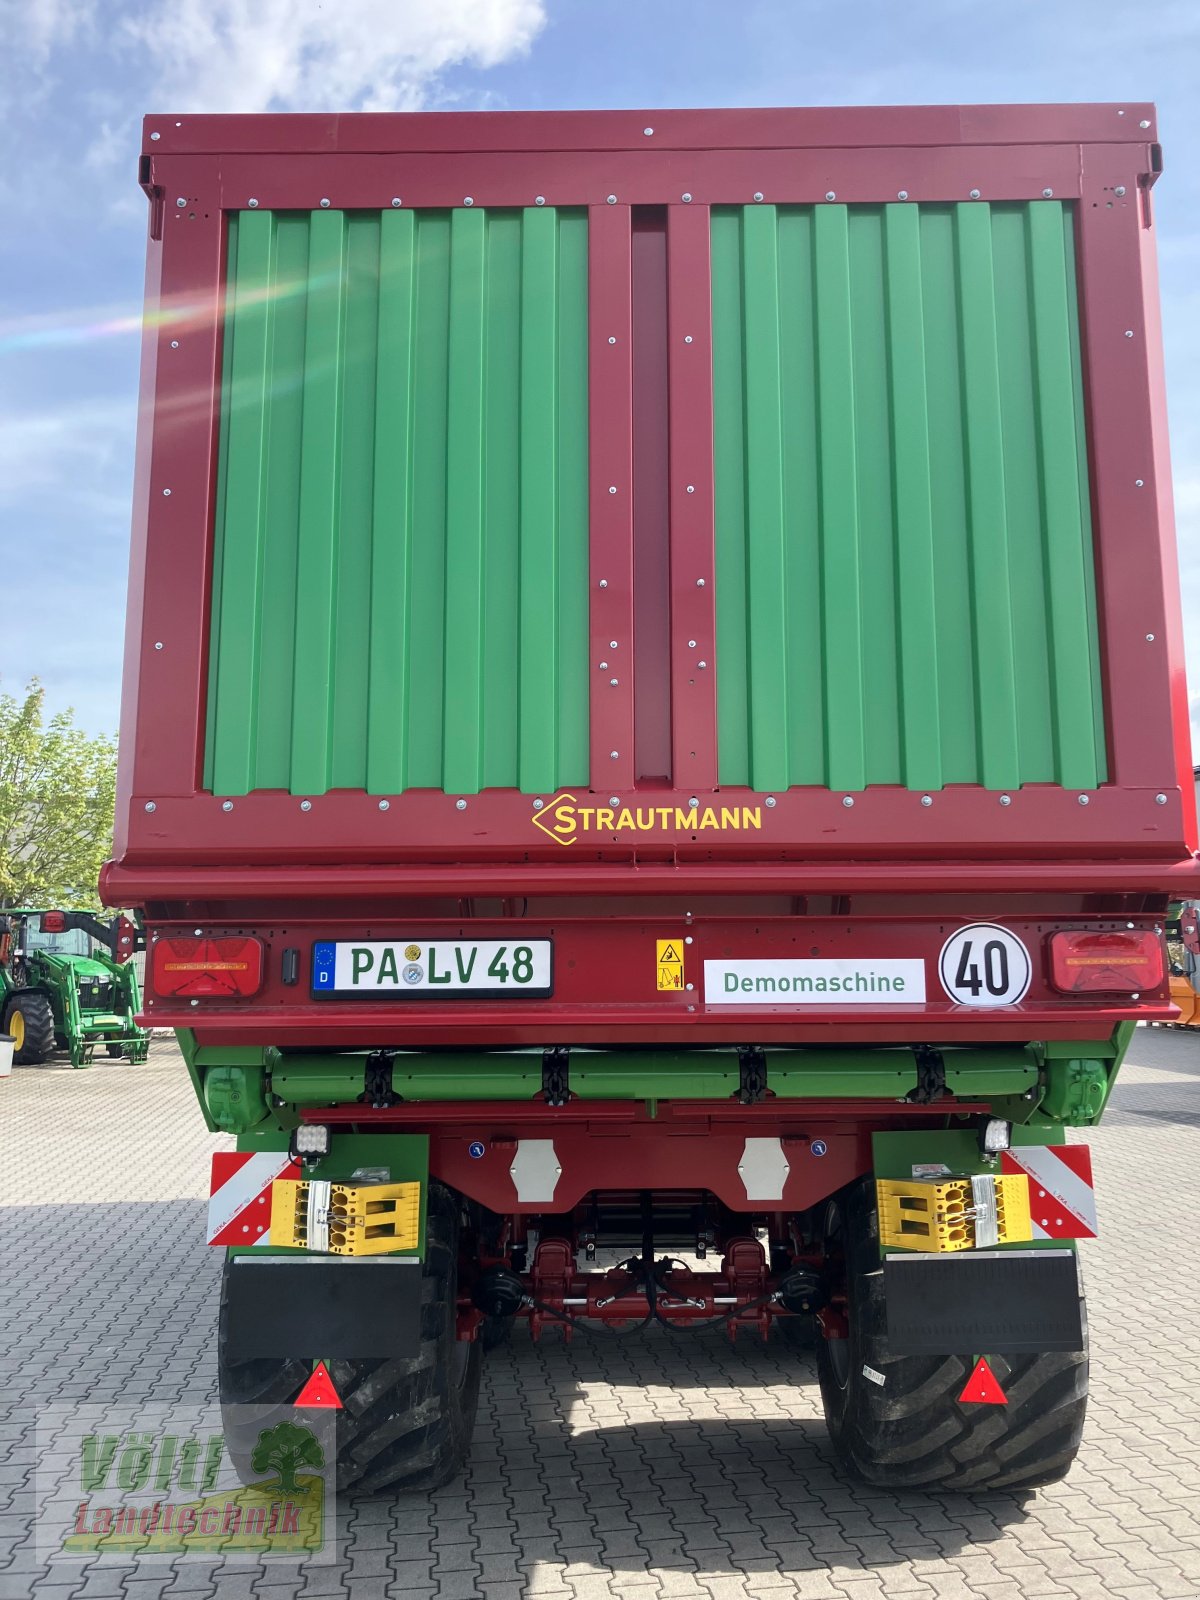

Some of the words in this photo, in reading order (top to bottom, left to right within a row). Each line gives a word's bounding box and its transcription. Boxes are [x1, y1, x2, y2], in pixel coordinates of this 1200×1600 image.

[553, 805, 762, 834] STRAUTMANN
[319, 972, 328, 982] D
[351, 948, 399, 984] PA
[428, 947, 478, 983] LV
[487, 946, 534, 983] 48
[955, 940, 1009, 996] 40
[724, 972, 905, 993] Demomaschine
[213, 1221, 227, 1235] GEKA
